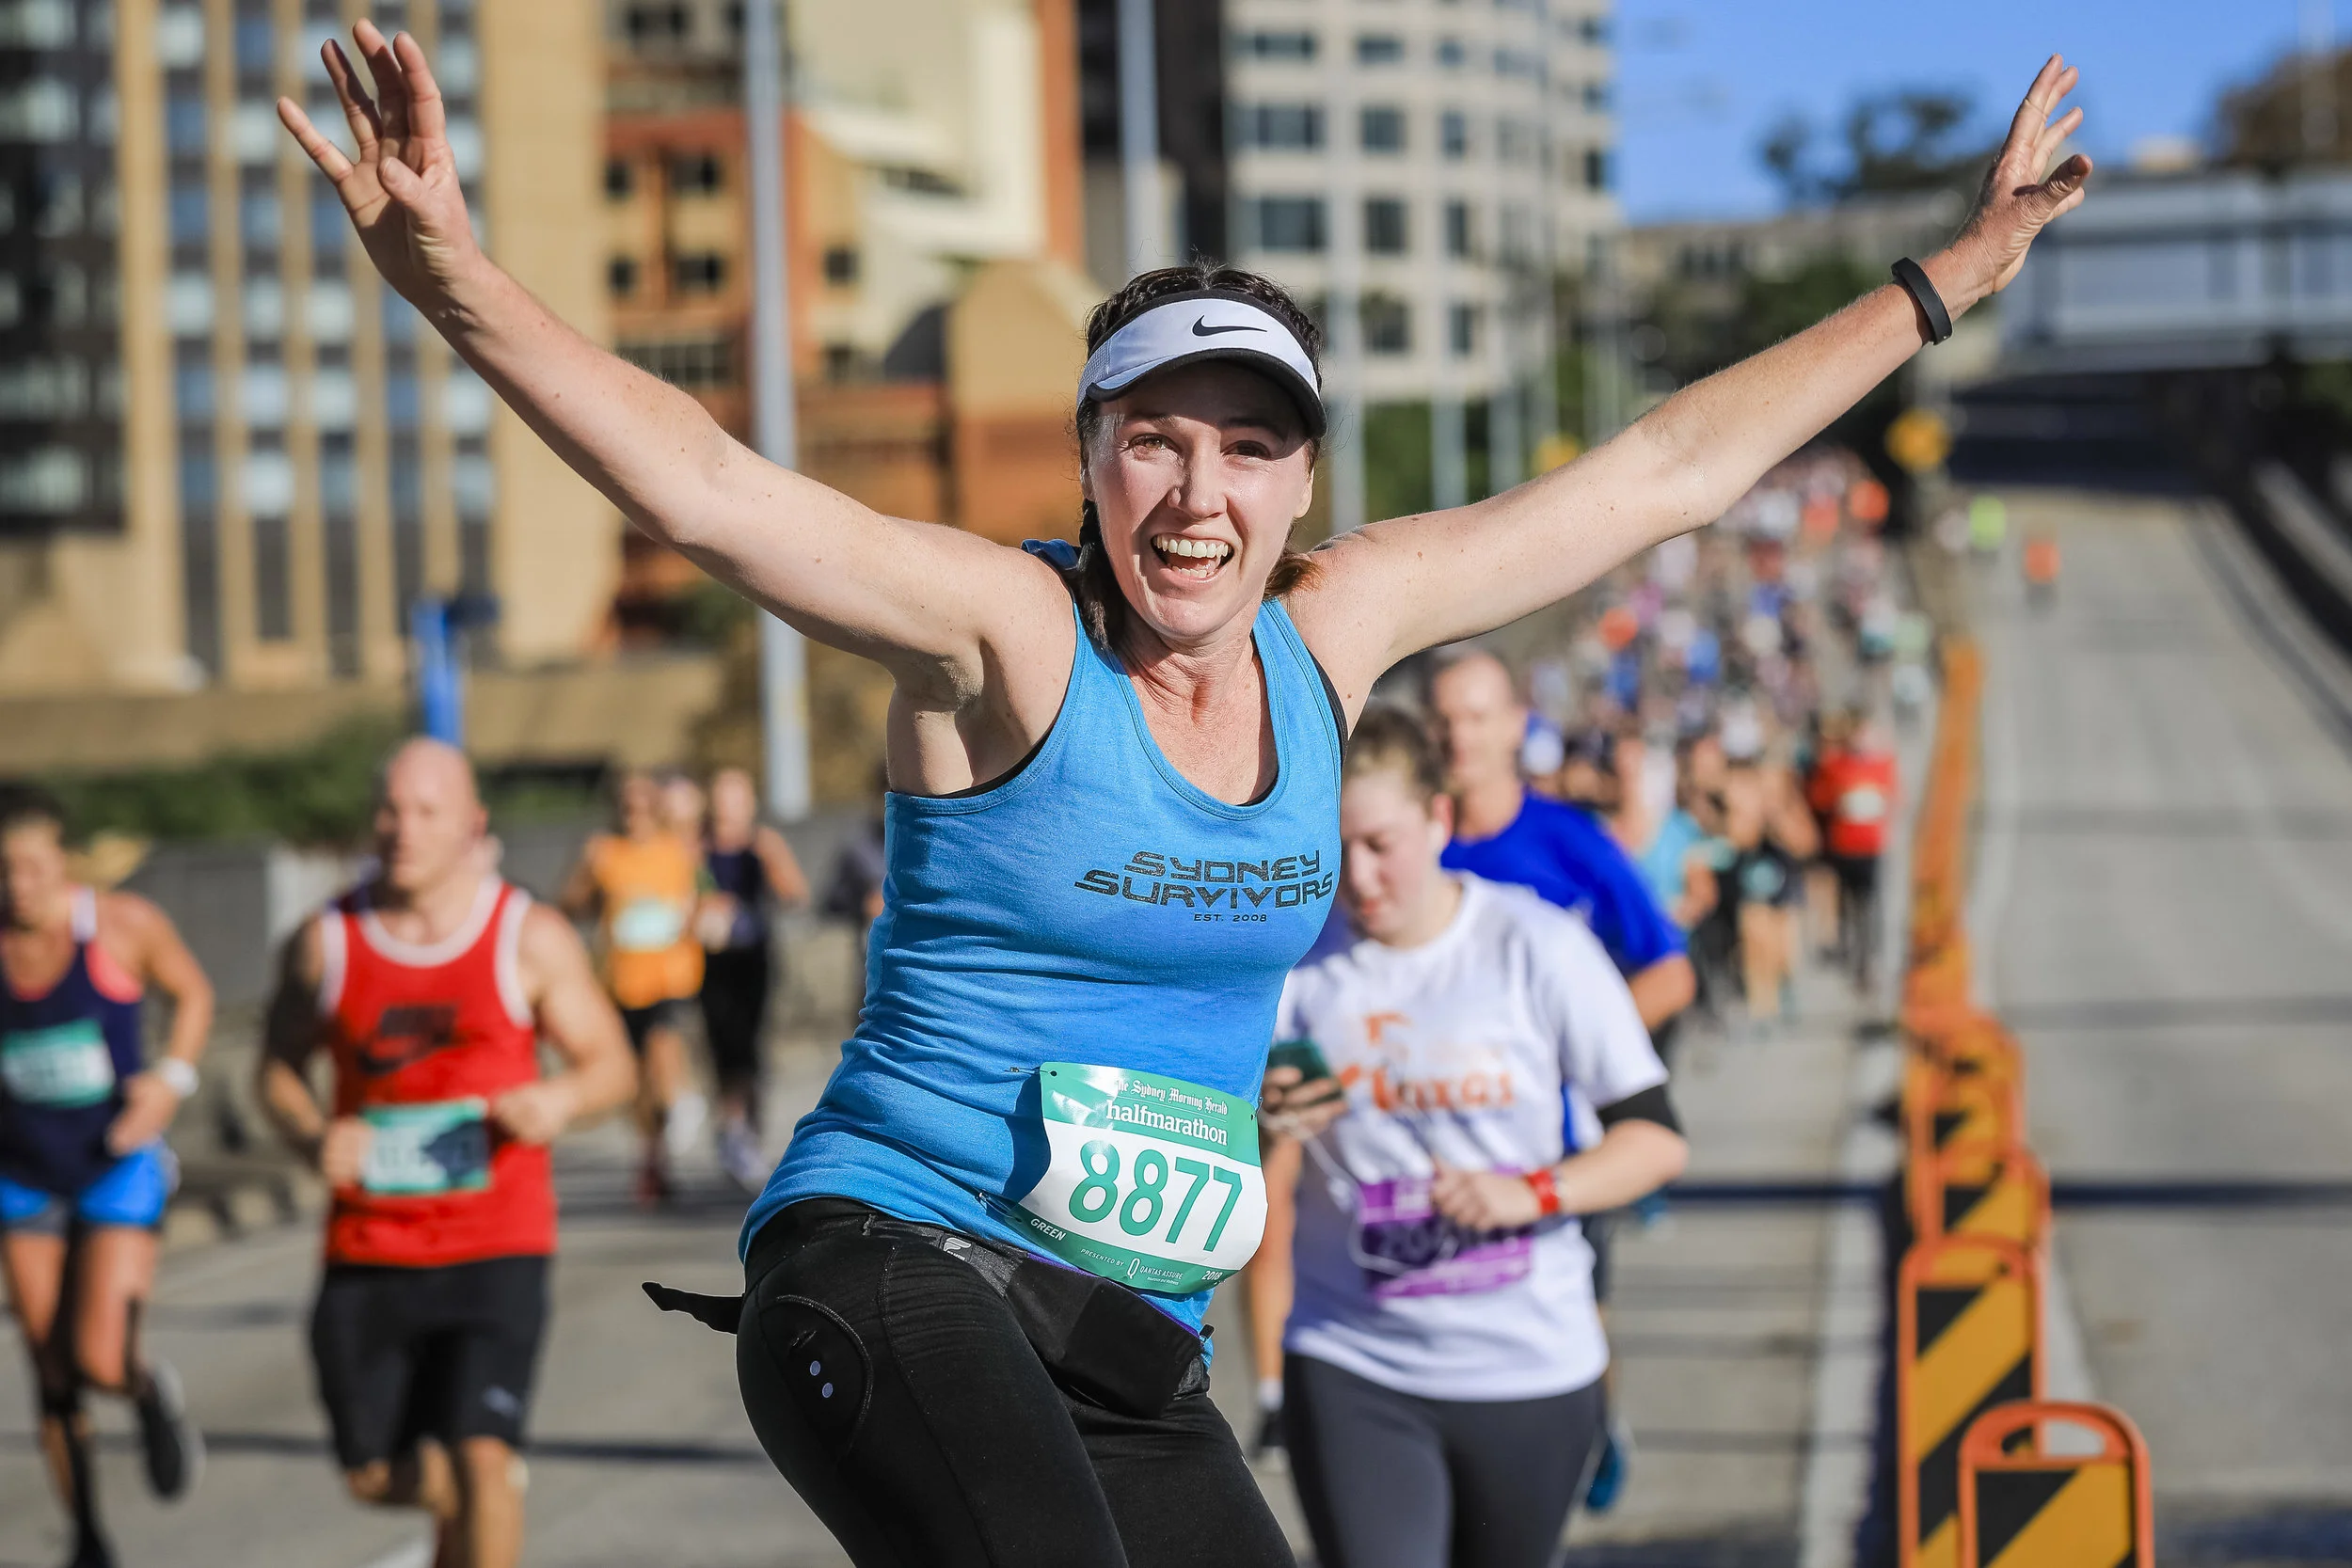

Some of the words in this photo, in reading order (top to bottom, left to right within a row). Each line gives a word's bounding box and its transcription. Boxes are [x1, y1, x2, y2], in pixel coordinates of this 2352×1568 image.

[1124, 849, 1320, 884] SYDNEY
[1073, 868, 1334, 910] SURVIVORS
[1193, 913, 1224, 923] EST.
[1232, 913, 1267, 923] 2008
[1131, 1079, 1167, 1102] Sydney
[1168, 1087, 1203, 1111] Morning
[1204, 1096, 1228, 1116] Herald
[1105, 1099, 1228, 1147] halfmarathon
[1068, 1139, 1243, 1253] 8877
[1030, 1218, 1067, 1242] GREEN
[1080, 1248, 1115, 1265] PRESENTED
[1115, 1259, 1125, 1267] BY
[1139, 1265, 1162, 1276] QANTAS
[1162, 1270, 1184, 1280] ASSURE
[1200, 1270, 1224, 1281] 2018
